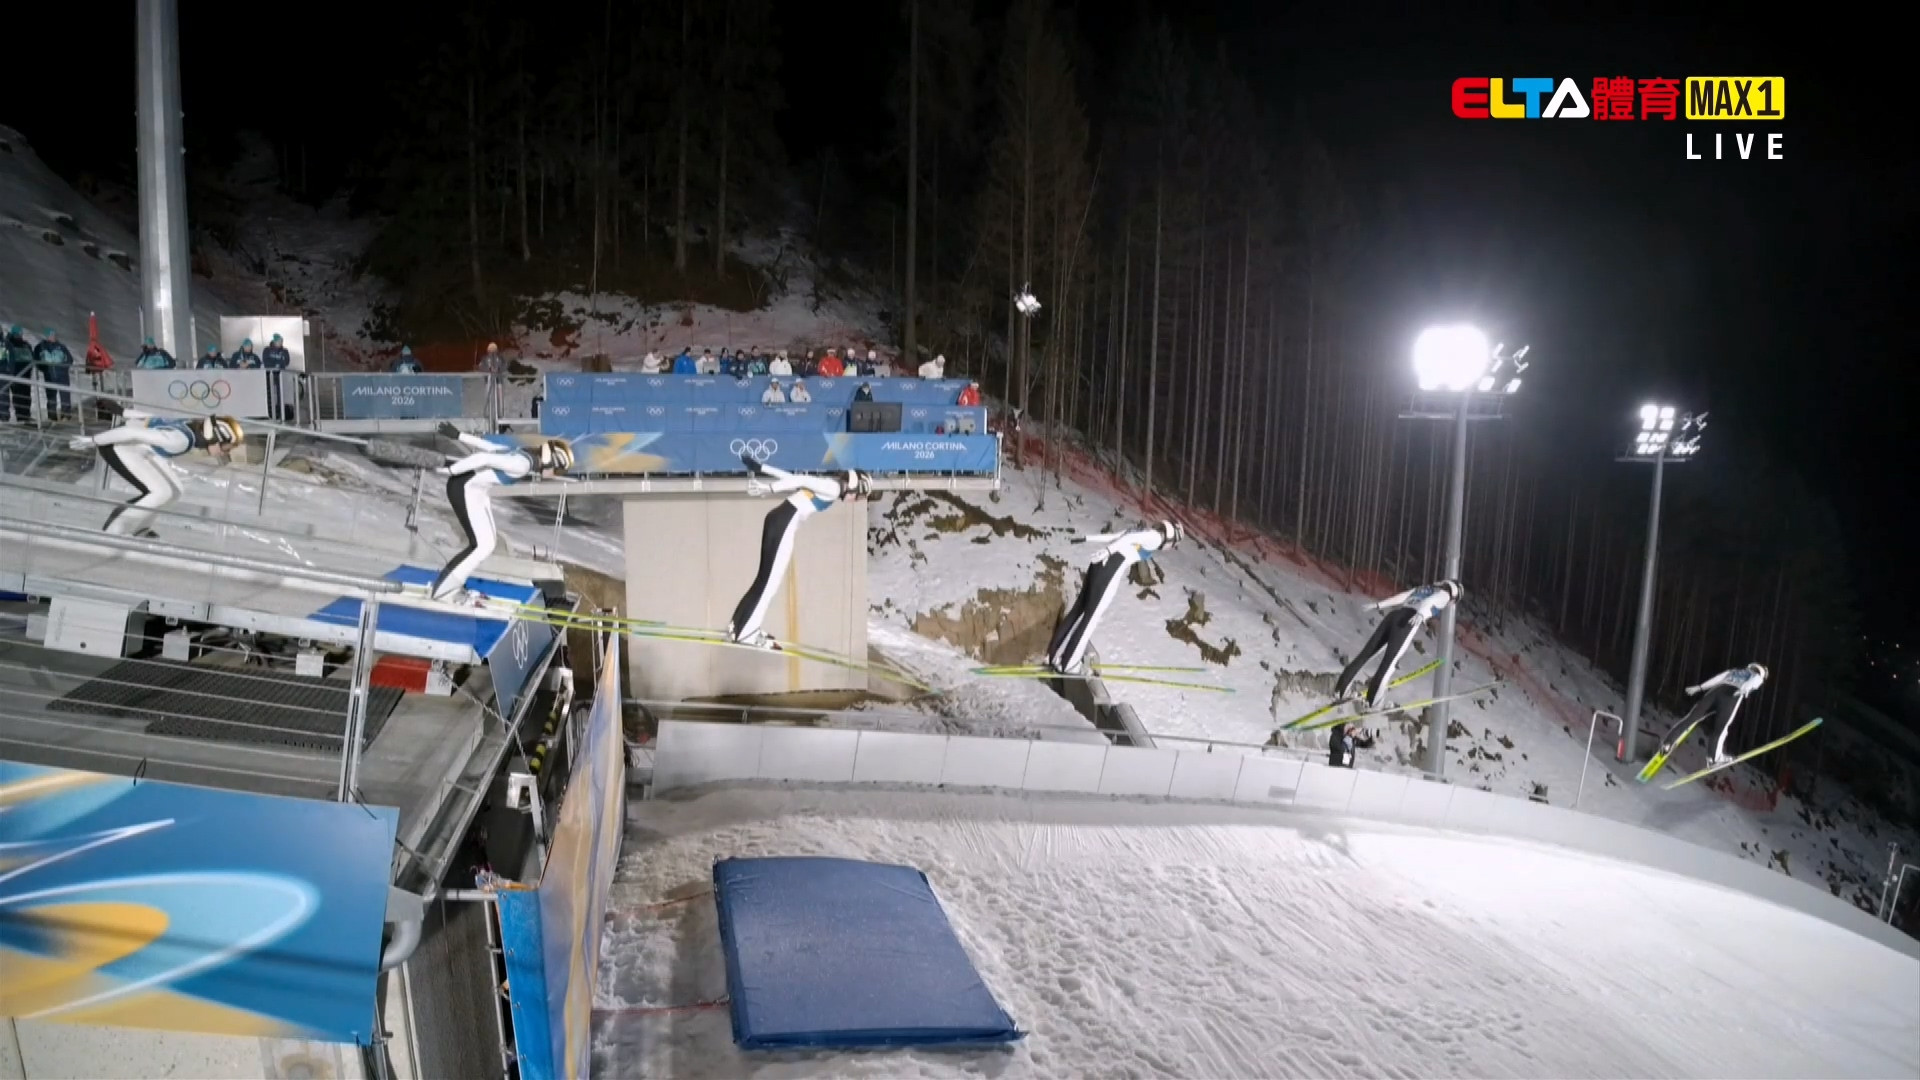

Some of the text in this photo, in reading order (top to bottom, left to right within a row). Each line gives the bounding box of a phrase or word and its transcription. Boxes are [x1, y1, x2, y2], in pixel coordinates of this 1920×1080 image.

[352, 386, 453, 395] MILANO CORTINA
[391, 396, 415, 405] 2026
[881, 441, 967, 451] MILANO CORTINA
[914, 450, 935, 459] 2026
